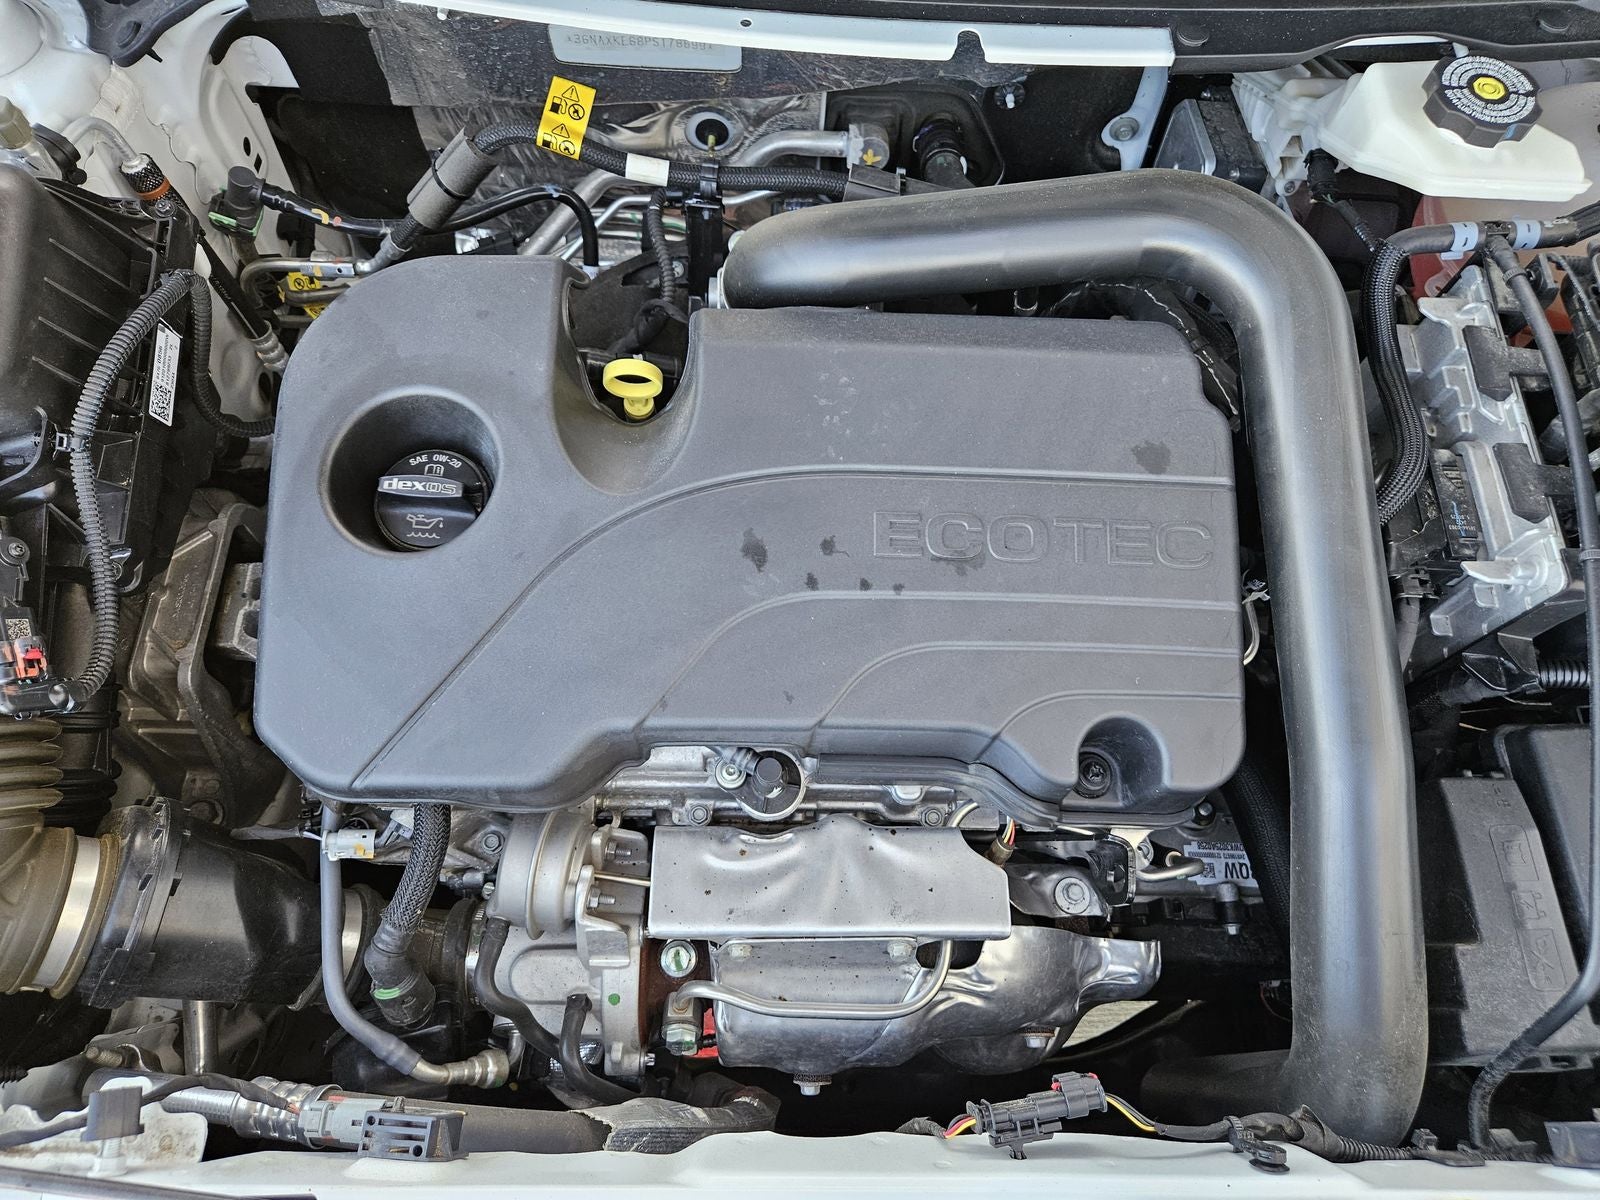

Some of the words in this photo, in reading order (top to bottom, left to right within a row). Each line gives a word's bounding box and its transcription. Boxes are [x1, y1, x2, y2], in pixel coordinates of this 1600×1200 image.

[408, 454, 429, 466] SAE
[432, 454, 462, 469] 0W-20
[382, 478, 457, 495] dexos
[873, 511, 1212, 569] ECOTEC
